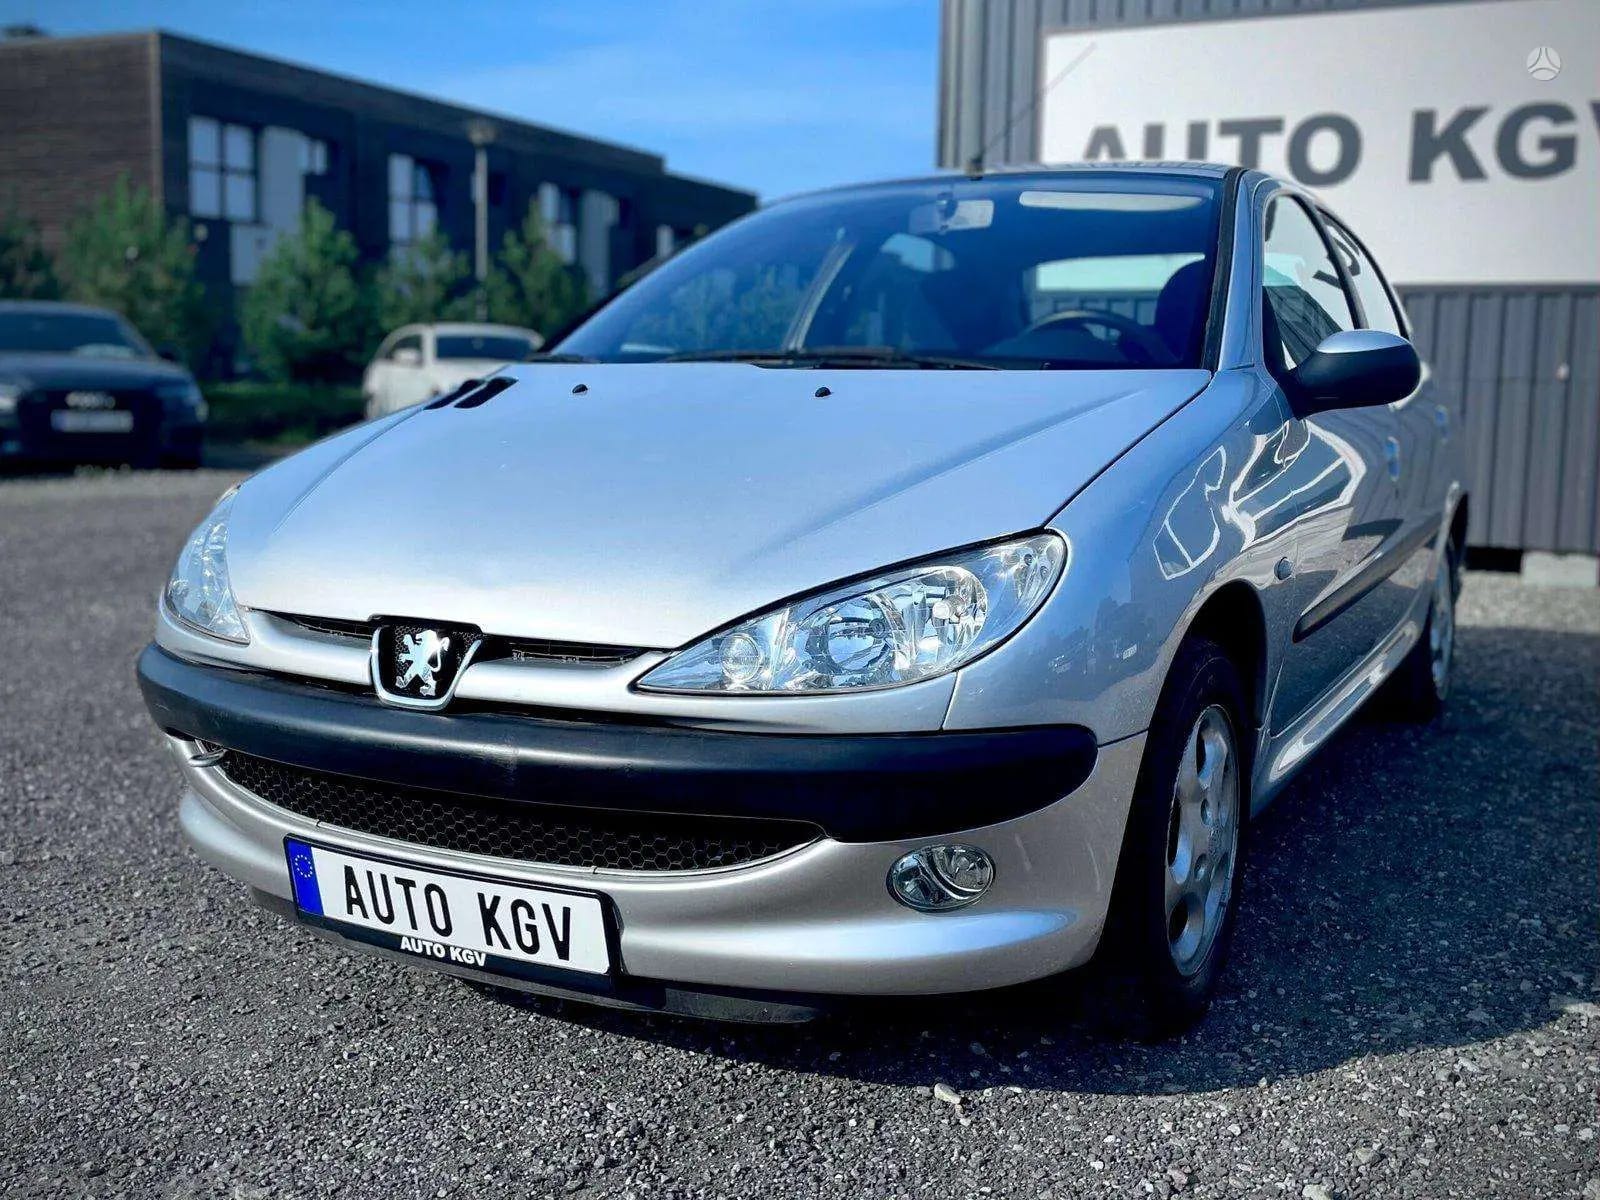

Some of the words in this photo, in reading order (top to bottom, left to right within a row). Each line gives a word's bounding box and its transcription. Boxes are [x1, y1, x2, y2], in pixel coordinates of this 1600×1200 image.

[1409, 102, 1600, 184] KG
[344, 864, 453, 938] AUTO
[477, 892, 571, 962] KGV
[400, 936, 446, 958] AUTO
[449, 946, 487, 967] KGV
